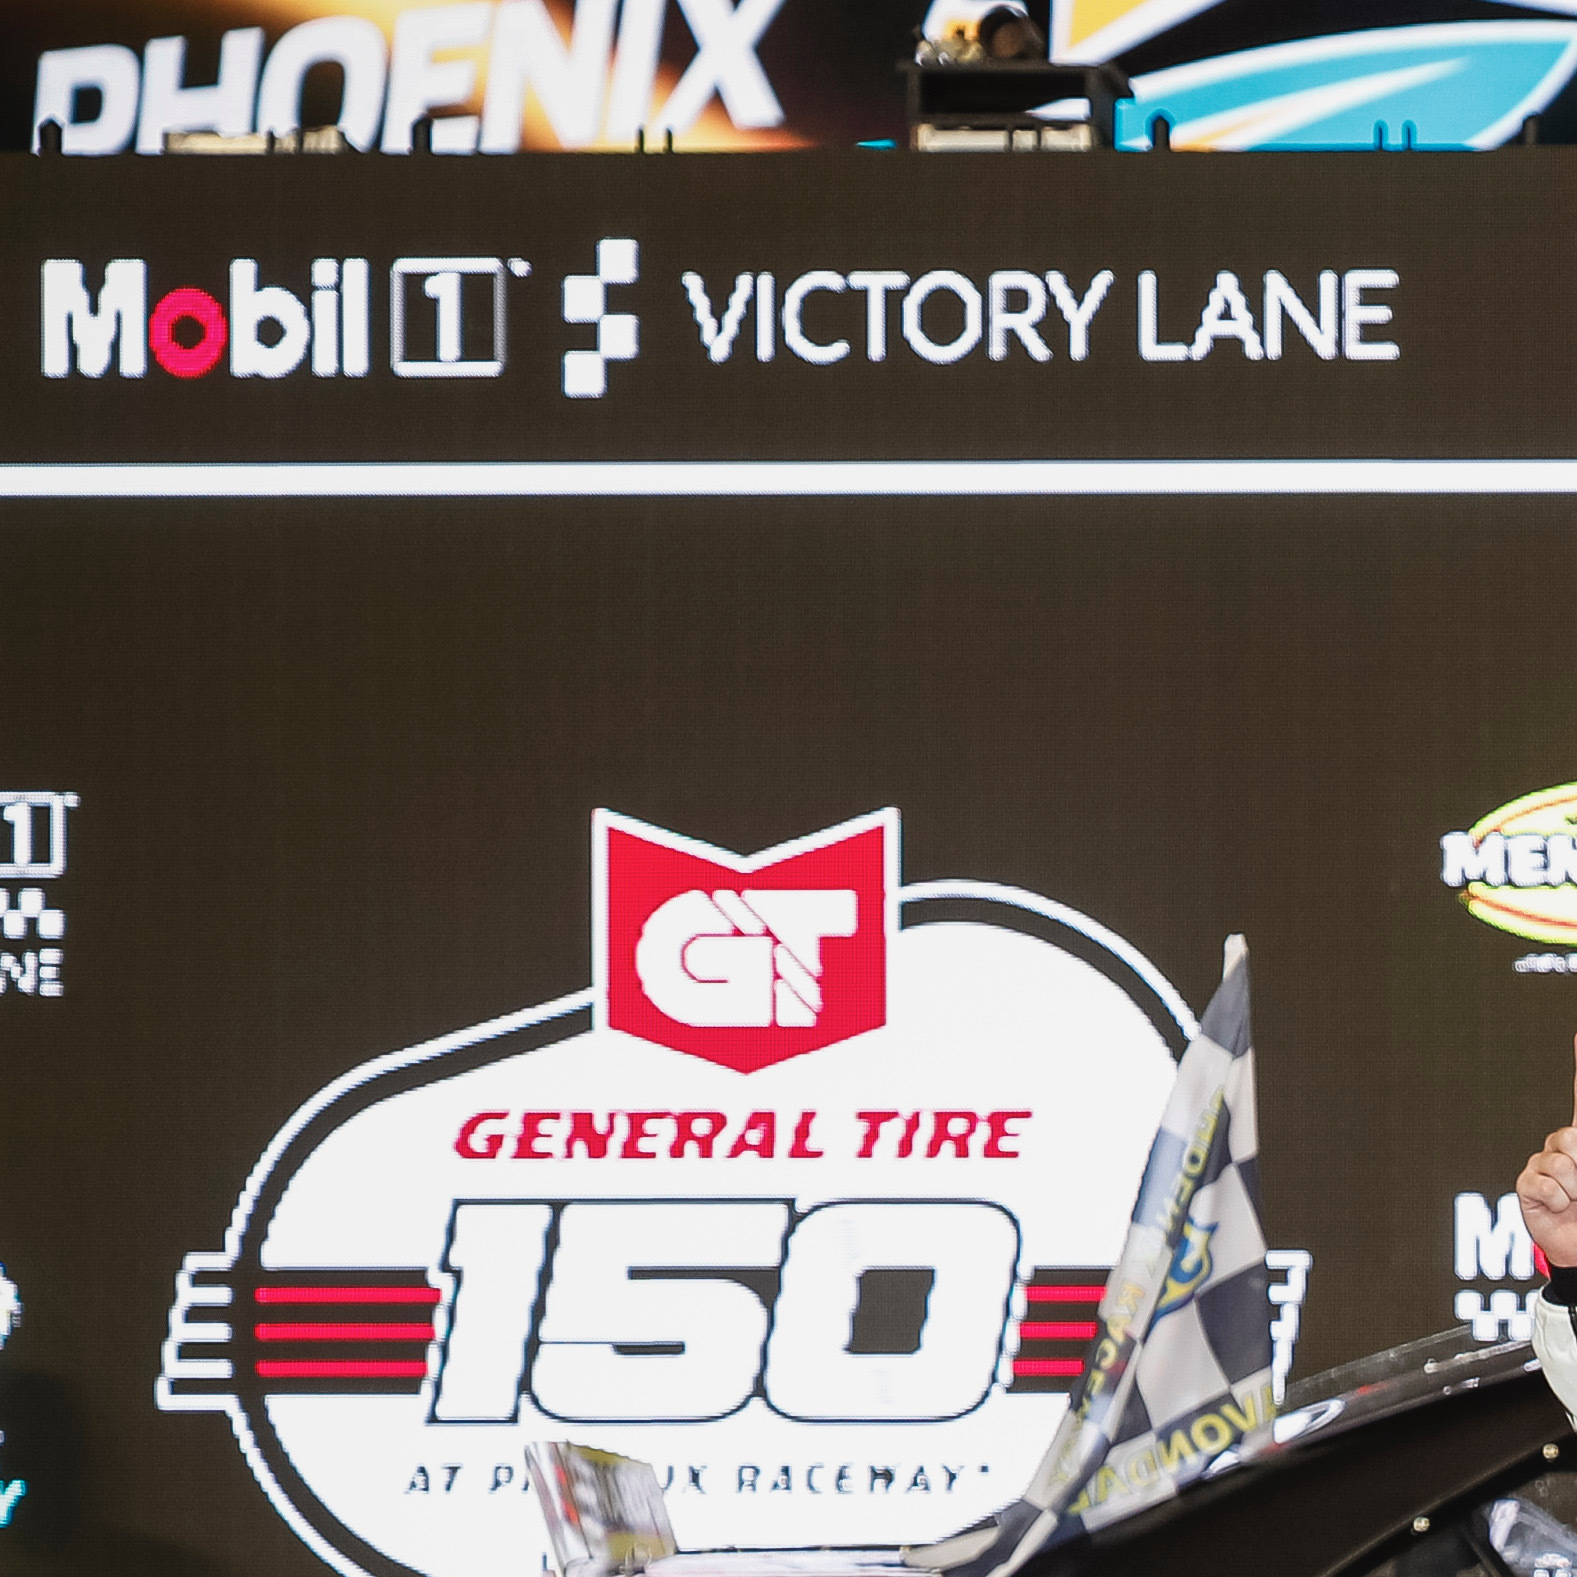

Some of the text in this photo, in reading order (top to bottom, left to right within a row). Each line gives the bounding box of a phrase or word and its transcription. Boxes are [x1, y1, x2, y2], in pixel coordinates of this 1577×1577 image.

[32, 0, 785, 155] PHOENIX
[40, 257, 370, 379] Mobil
[682, 269, 1114, 365] VICTORY
[1138, 269, 1400, 363] LANE
[635, 888, 859, 1028] GT
[453, 1109, 1033, 1161] GENERAL TIRE
[424, 1199, 1021, 1426] 150
[403, 1462, 464, 1494] AT
[736, 1462, 964, 1495] RACEWAY
